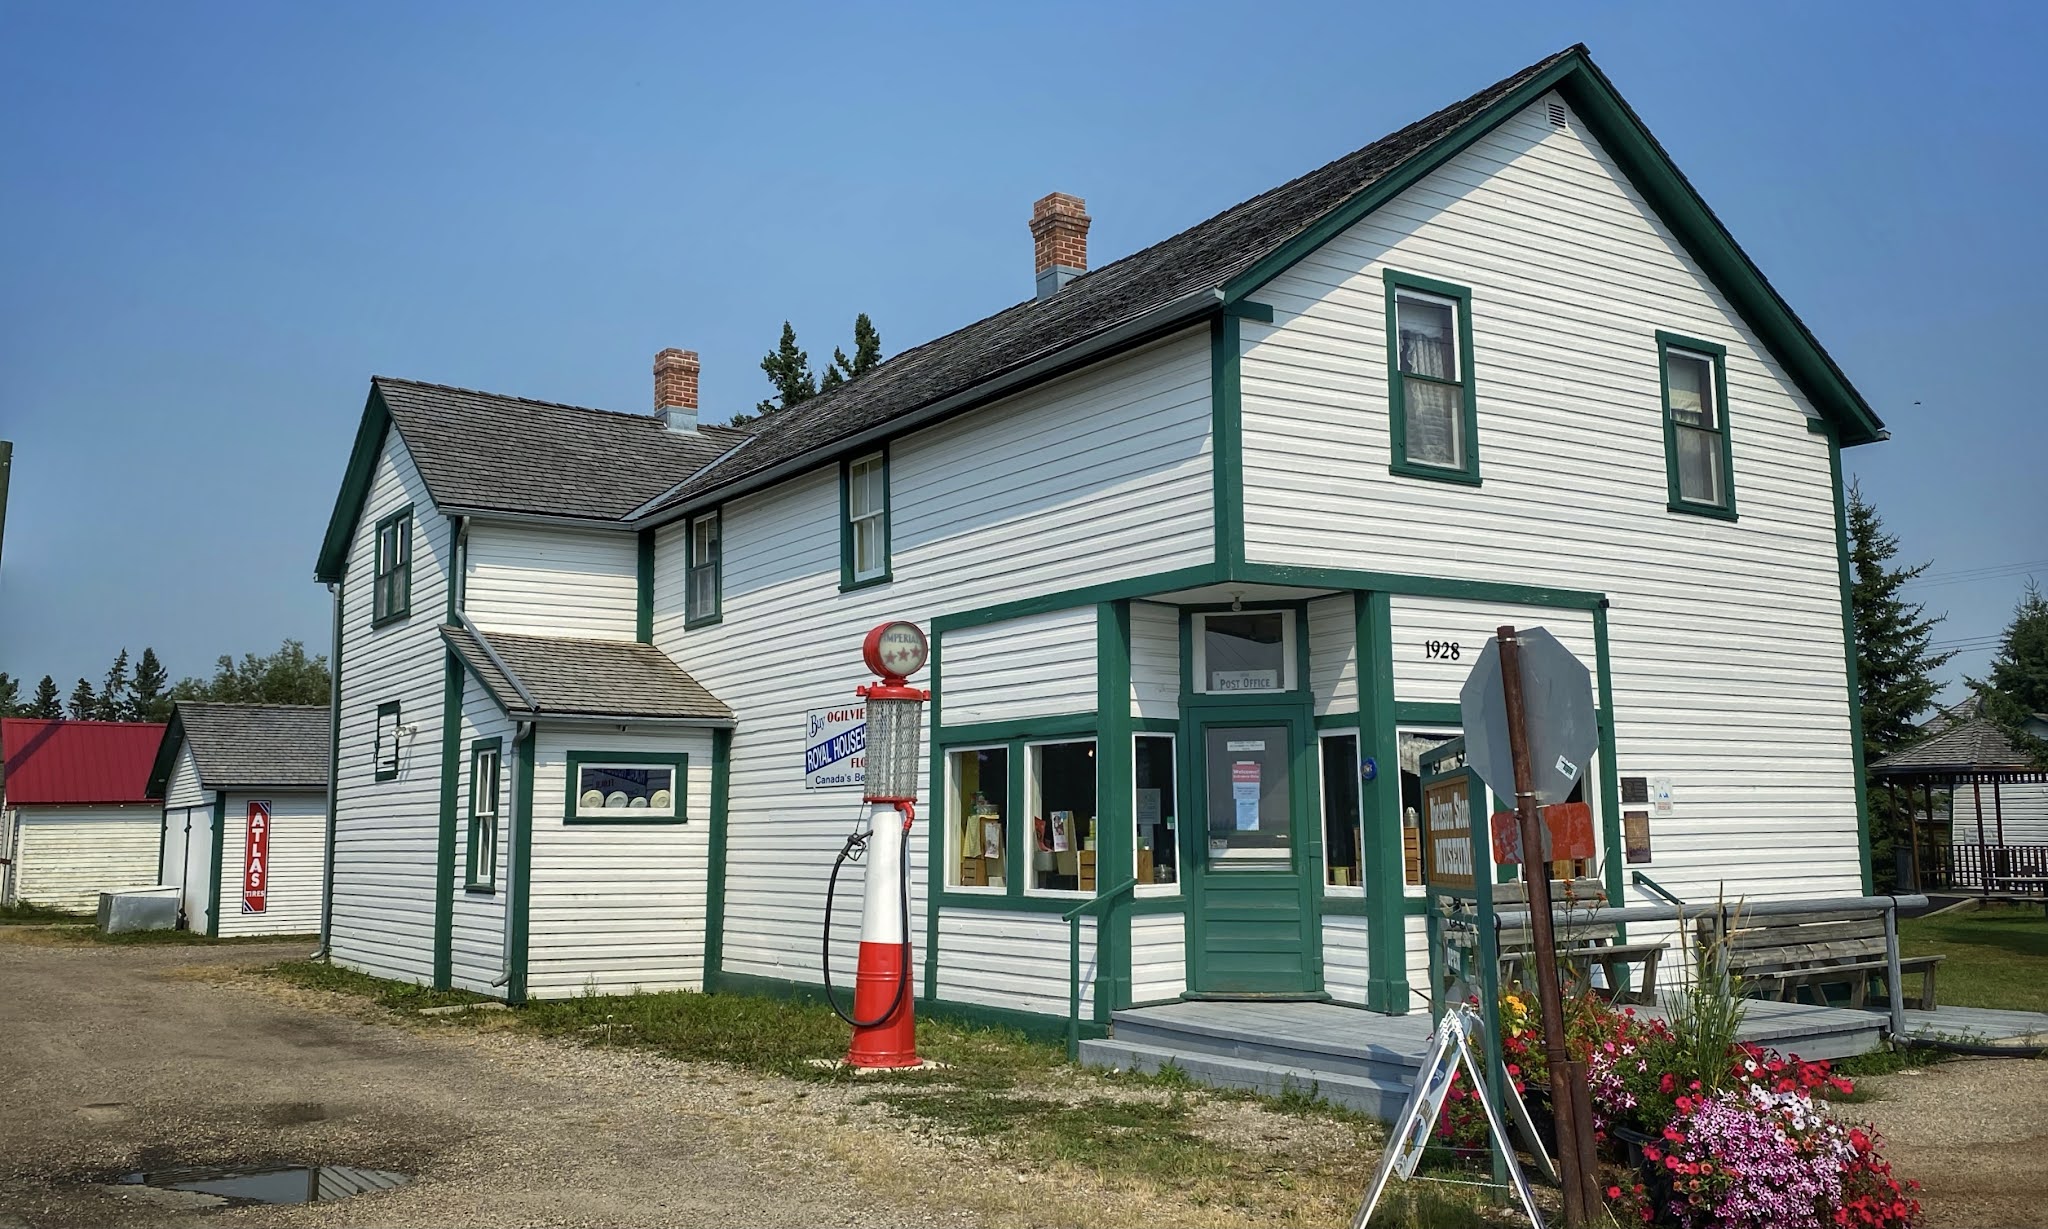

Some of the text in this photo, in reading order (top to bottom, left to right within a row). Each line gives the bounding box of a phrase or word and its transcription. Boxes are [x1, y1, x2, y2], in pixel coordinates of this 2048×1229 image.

[1425, 640, 1460, 660] 1928
[1220, 678, 1271, 689] POST OFFICE
[809, 714, 825, 738] Buy
[807, 725, 866, 772] ROYAL HOUSEH
[851, 758, 866, 769] FLO
[815, 773, 865, 784] Canada's Be
[1453, 791, 1472, 830] Stor
[249, 812, 265, 887] ATLAS
[245, 890, 265, 898] TIRES
